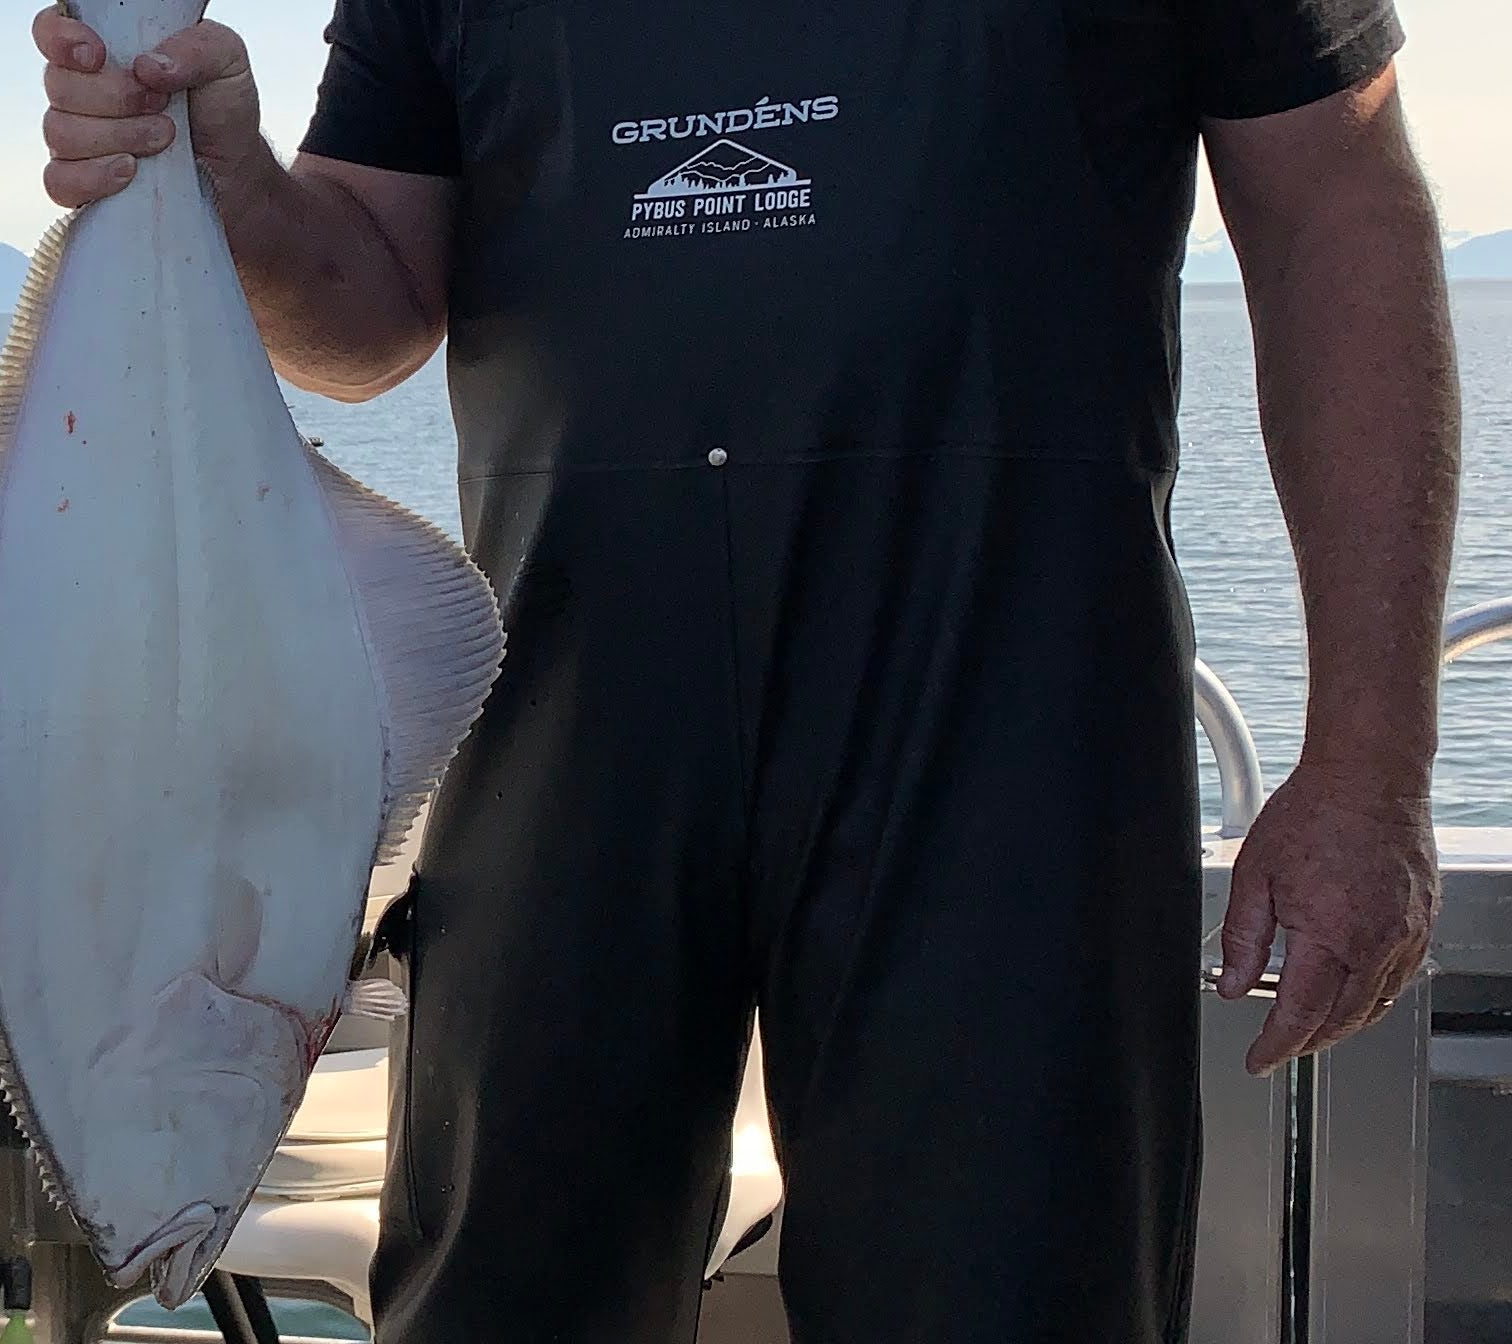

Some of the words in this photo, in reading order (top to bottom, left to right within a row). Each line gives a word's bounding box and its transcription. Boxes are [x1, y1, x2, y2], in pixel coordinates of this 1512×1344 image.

[611, 96, 839, 144] GRUNDÉNS
[631, 199, 686, 221] PYBUS
[693, 194, 747, 216] POINT
[754, 188, 811, 211] LODGE
[623, 223, 696, 239] ADMIRALTY
[701, 218, 751, 234] ISLAND
[763, 213, 817, 229] ALASKA
